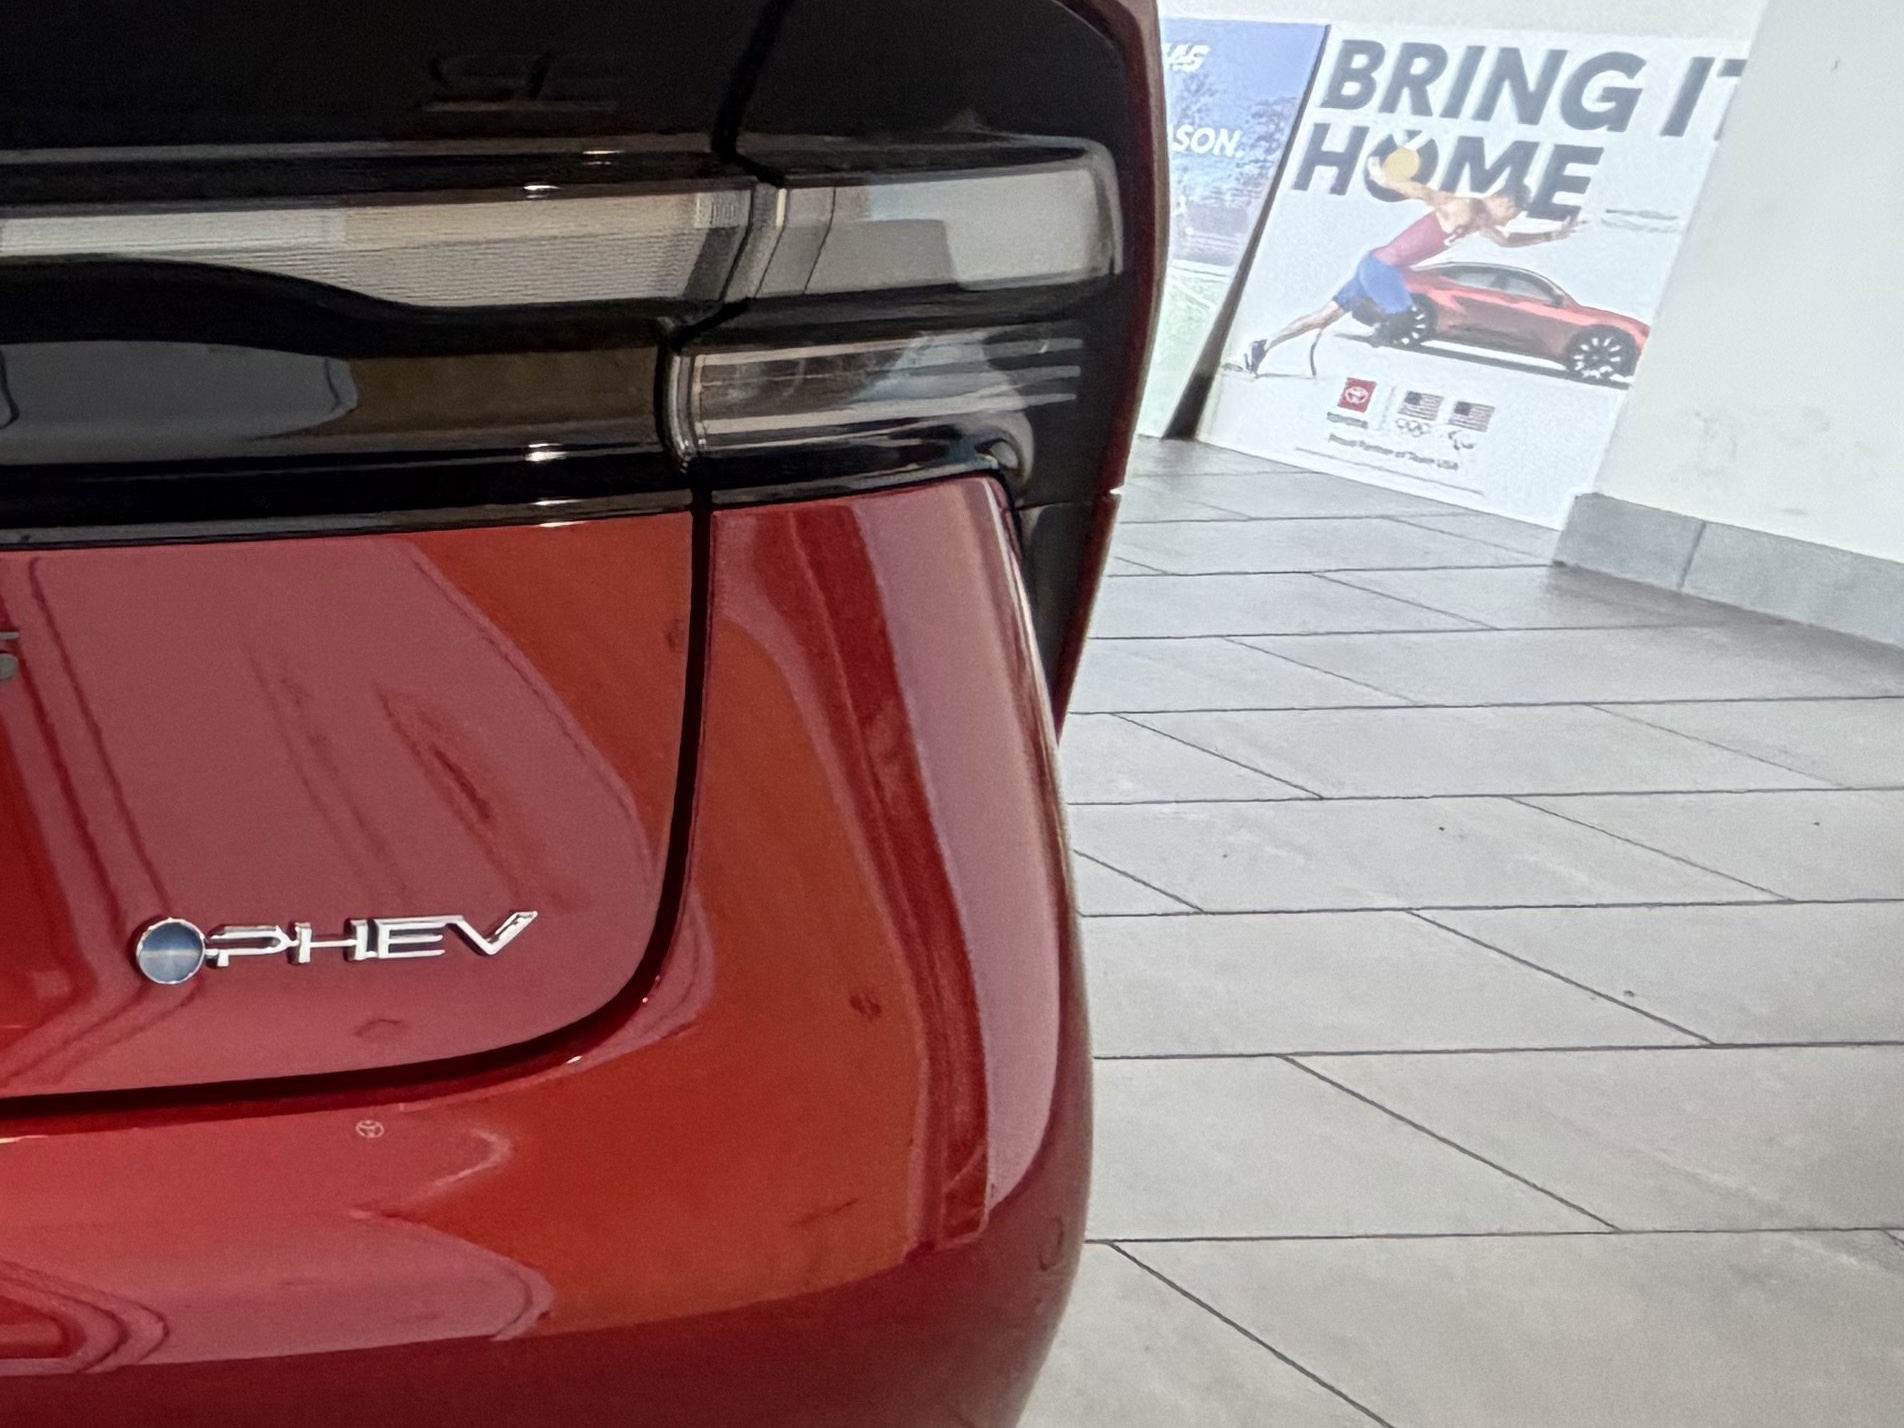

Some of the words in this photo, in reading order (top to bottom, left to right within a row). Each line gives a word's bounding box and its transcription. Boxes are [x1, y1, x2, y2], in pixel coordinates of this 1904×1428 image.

[1319, 39, 1647, 132] BRING
[1168, 123, 1246, 158] SON.
[1291, 122, 1605, 221] HOME
[205, 910, 538, 968] PHEV
